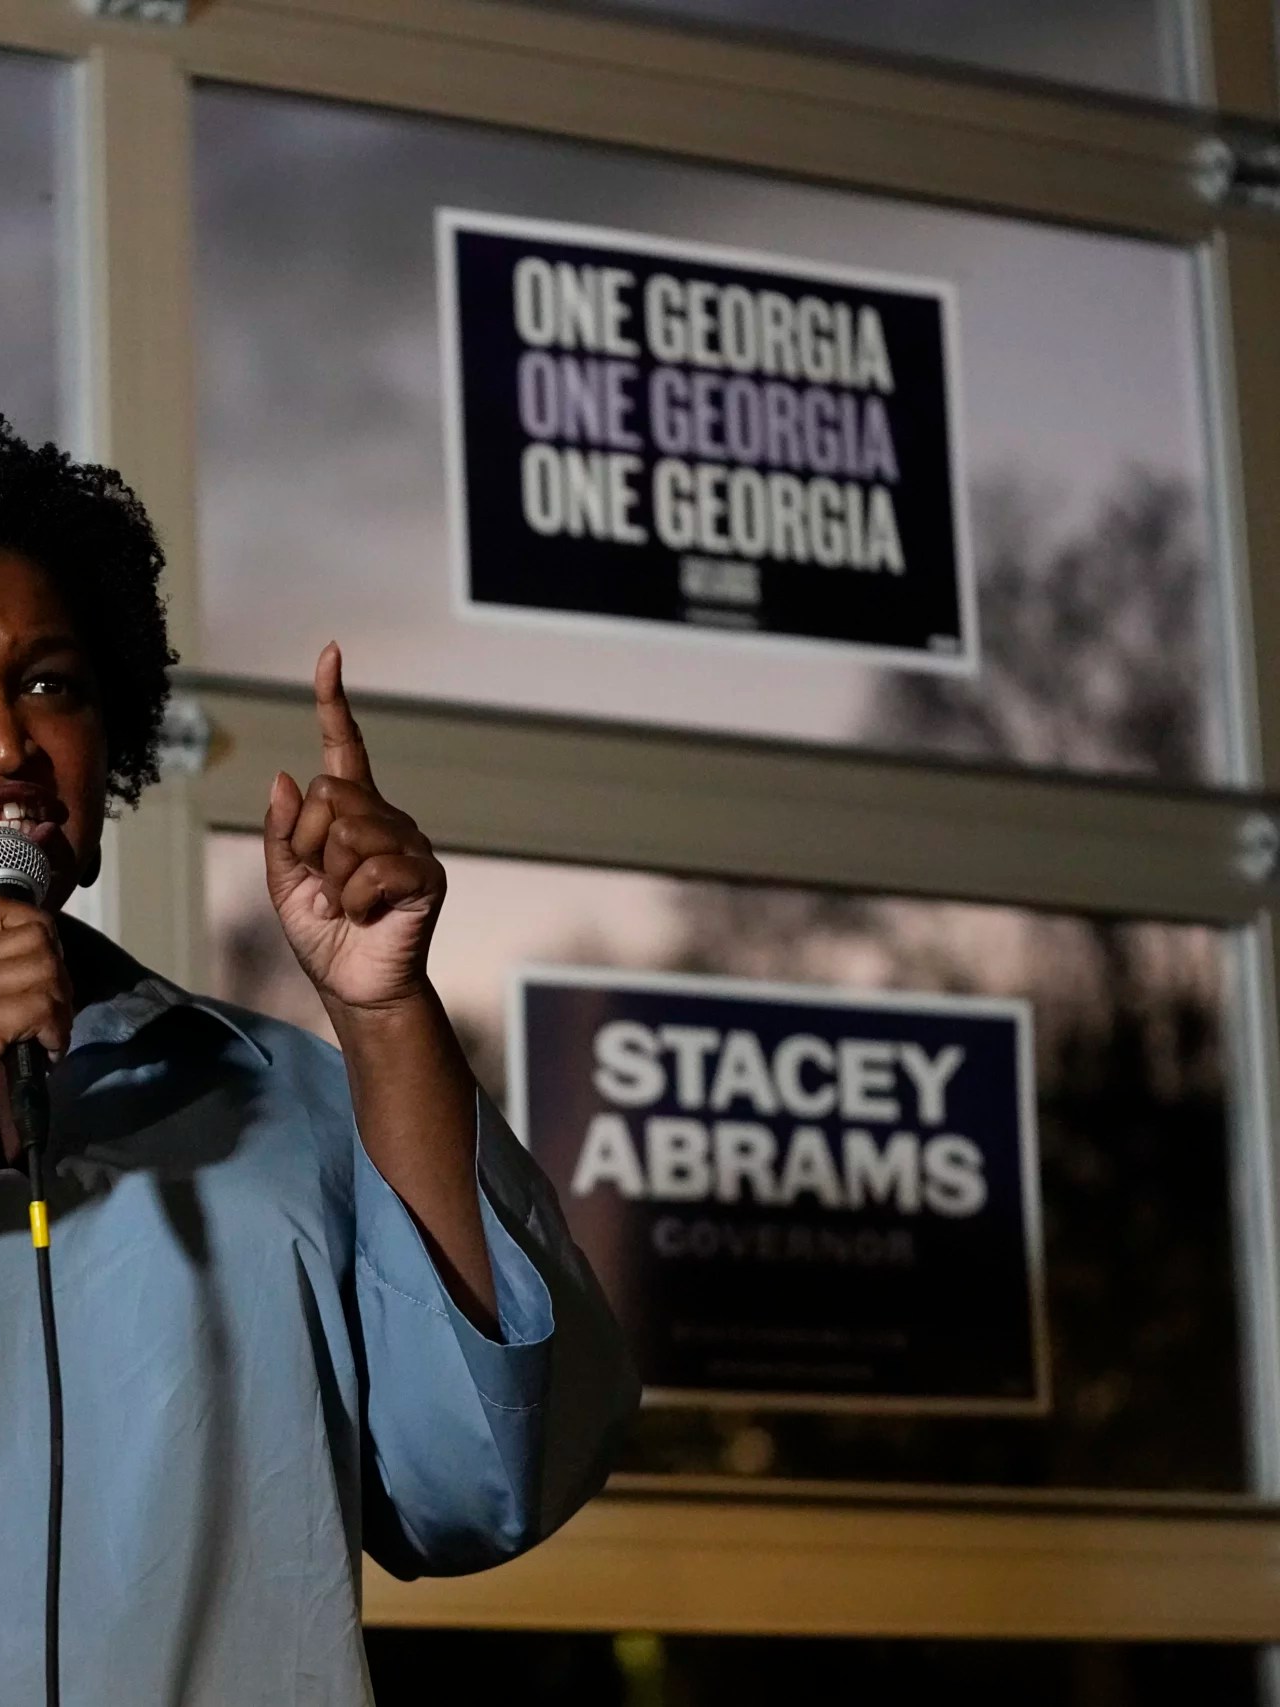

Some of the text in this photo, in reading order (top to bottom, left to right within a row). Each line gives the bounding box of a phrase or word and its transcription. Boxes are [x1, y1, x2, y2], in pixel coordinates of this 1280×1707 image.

[513, 256, 896, 394] ONE GEORGIA
[518, 351, 901, 483] ONE GEORGIA
[522, 442, 907, 577] ONE GEORGIA
[593, 1019, 965, 1126] STACEY
[572, 1111, 989, 1219] ABRAMS
[651, 1216, 916, 1268] GOVERNOR
